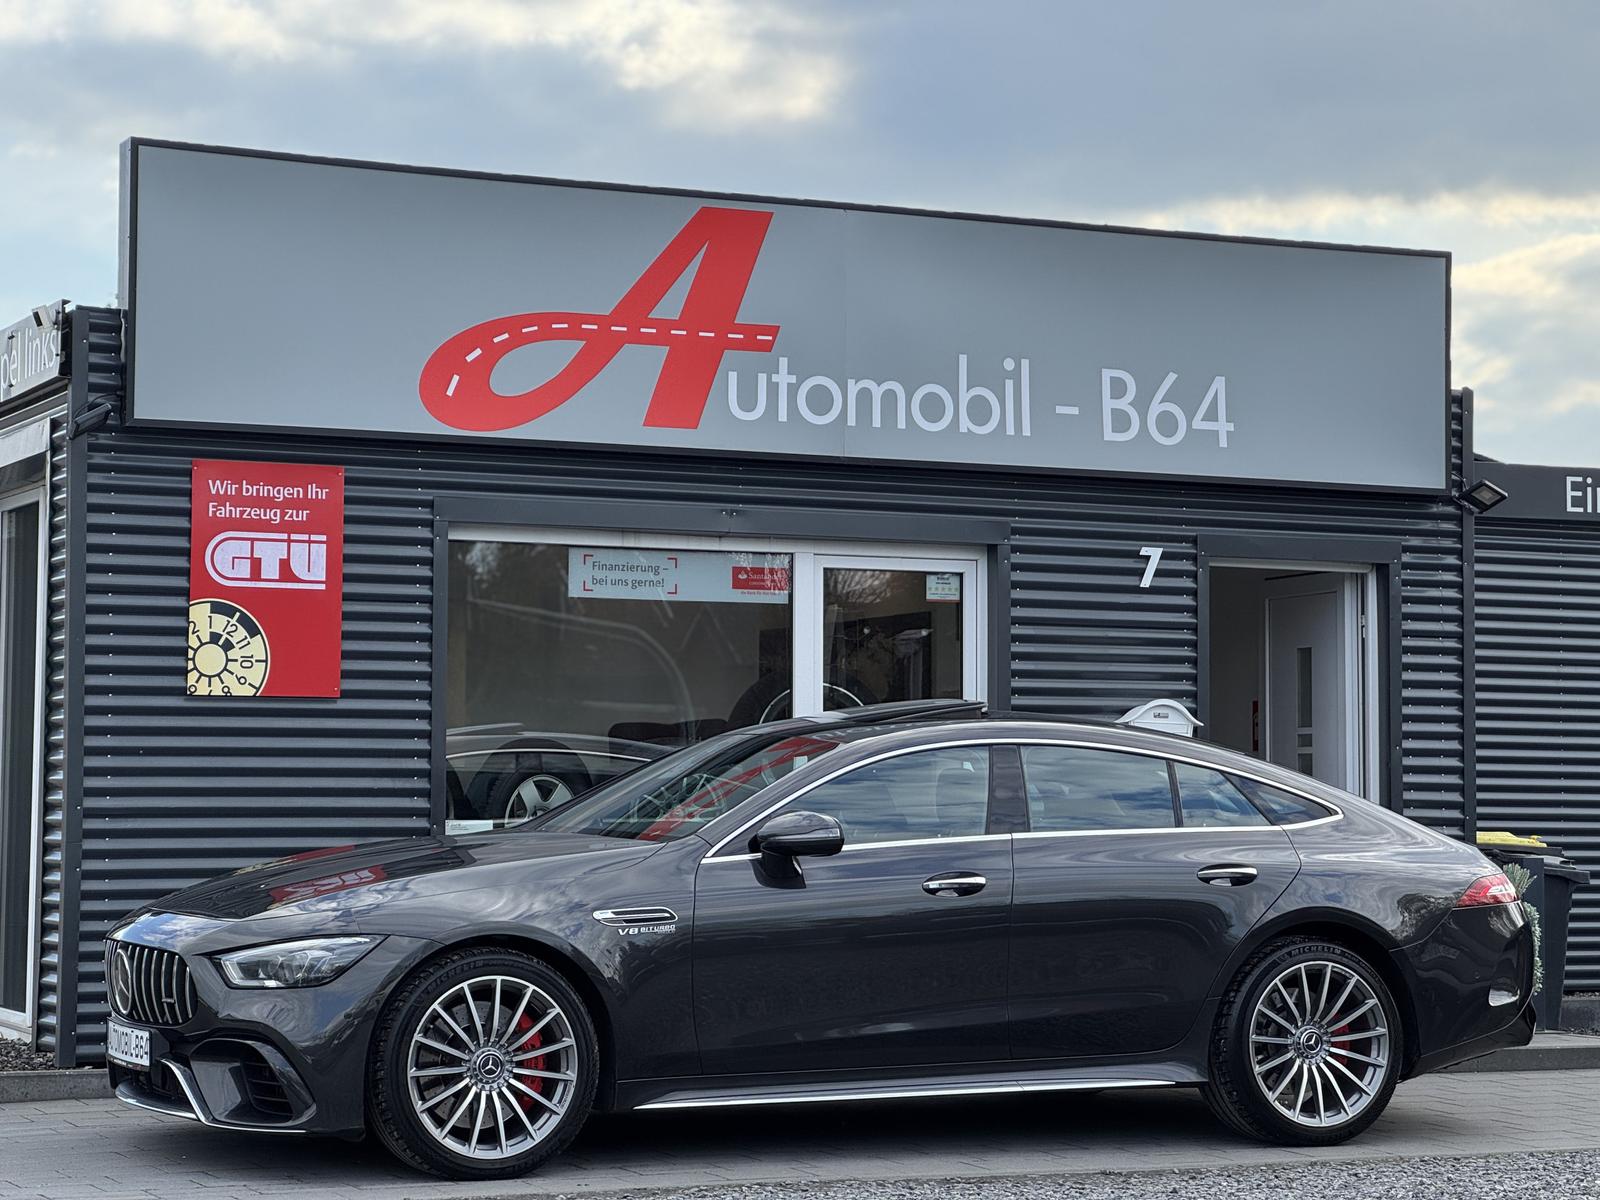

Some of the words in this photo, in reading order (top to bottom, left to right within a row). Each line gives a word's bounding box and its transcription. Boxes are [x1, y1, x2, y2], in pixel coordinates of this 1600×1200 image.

[1101, 368, 1235, 449] B64
[208, 479, 238, 496] Wir
[242, 480, 304, 501] bringen
[308, 483, 330, 499] Ihr
[1566, 476, 1600, 513] Ei
[208, 502, 281, 524] Fahrzeug
[284, 508, 310, 521] zur
[213, 532, 327, 582] GTÜ
[1139, 546, 1164, 588] 7
[592, 561, 661, 576] Finanzierung
[591, 574, 608, 586] bei
[611, 577, 629, 587] uns
[631, 578, 665, 590] gerne!
[222, 619, 238, 638] 12
[240, 654, 254, 669] 10
[617, 927, 639, 936] V8
[1291, 945, 1341, 956] MICHELIN
